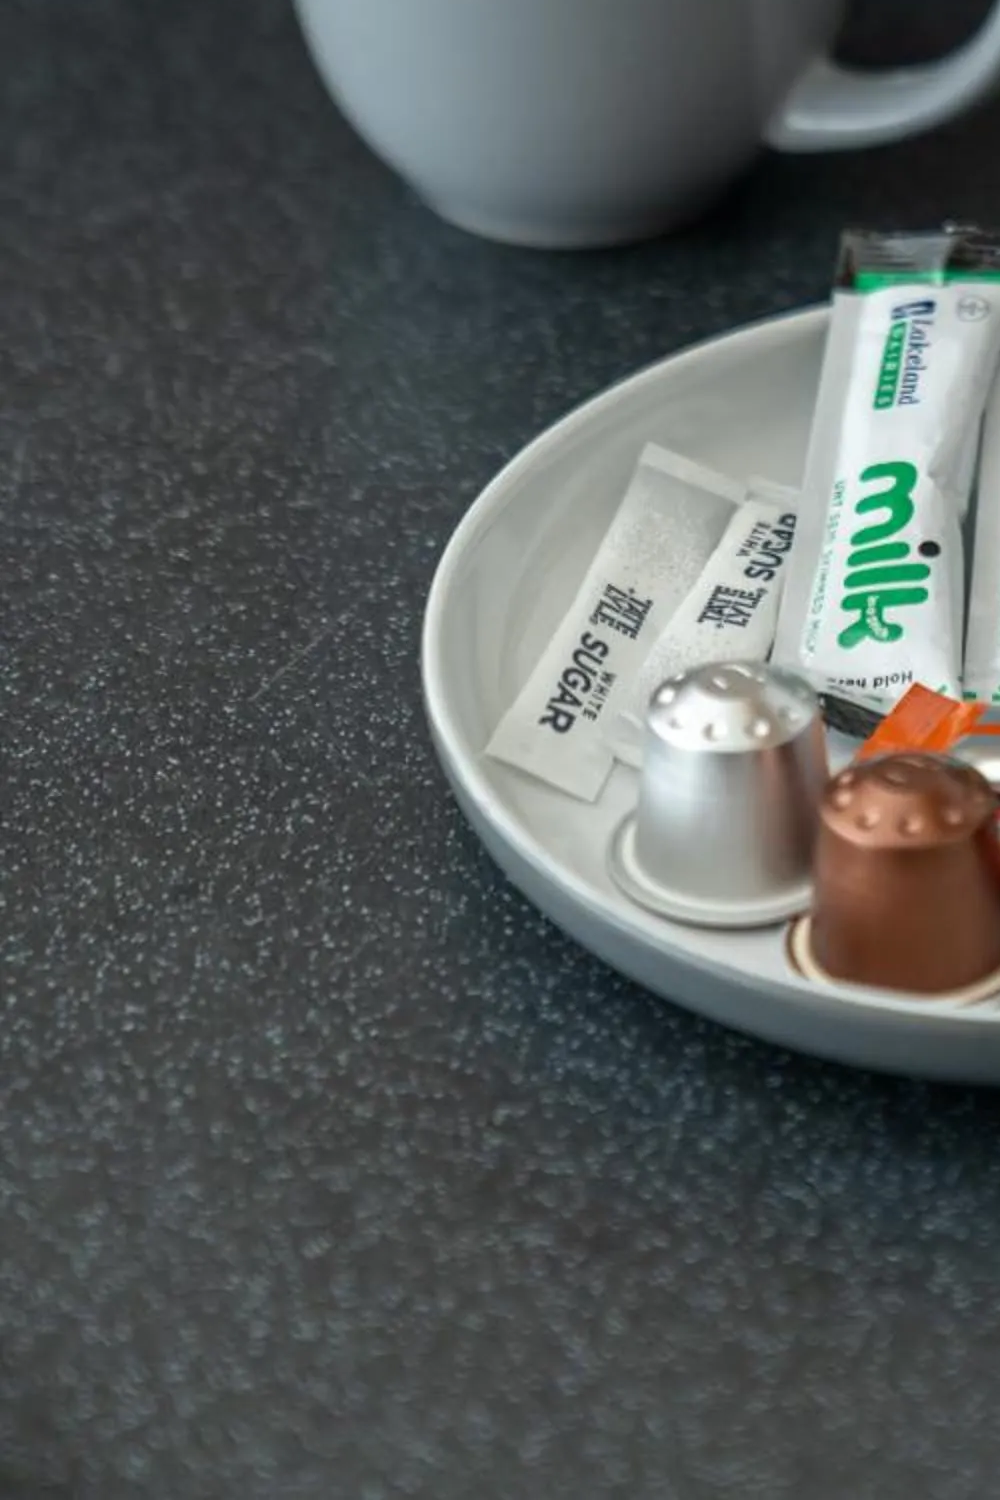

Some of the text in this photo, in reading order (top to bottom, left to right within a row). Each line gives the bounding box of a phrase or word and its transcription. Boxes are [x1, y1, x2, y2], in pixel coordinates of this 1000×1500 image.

[874, 321, 908, 408] DAIRIES
[898, 319, 935, 407] Lakeland
[838, 461, 941, 649] milk
[538, 631, 609, 734] SUGAR
[582, 672, 617, 722] WHITE
[872, 670, 914, 688] Hold
